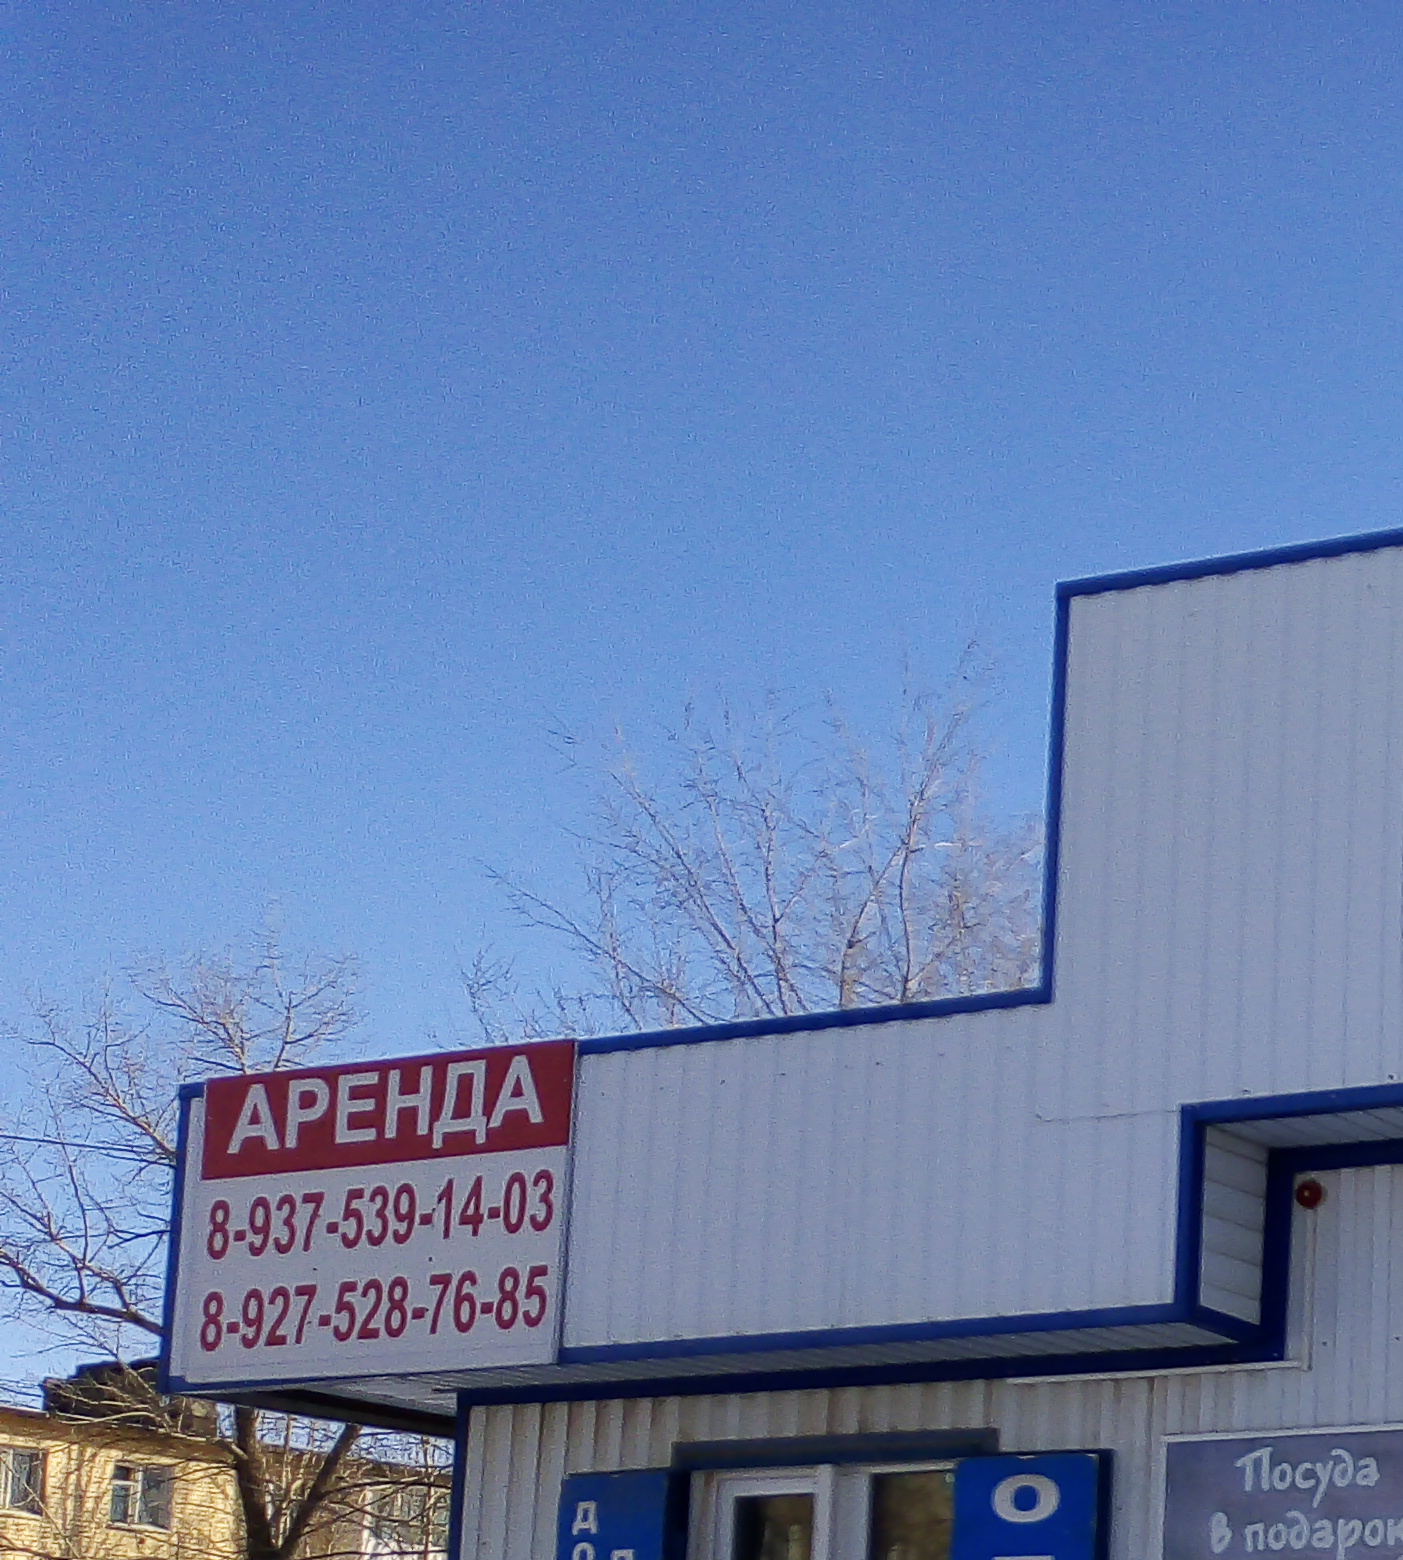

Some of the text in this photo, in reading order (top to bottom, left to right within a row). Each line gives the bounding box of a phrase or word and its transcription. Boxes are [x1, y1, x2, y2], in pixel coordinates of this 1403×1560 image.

[227, 1055, 544, 1154] АРЕНДА
[207, 1169, 555, 1260] 8-937-539-14-03
[200, 1265, 549, 1352] 8-927-528-76-85
[1236, 1448, 1380, 1508] Посуда
[1210, 1515, 1232, 1552] в
